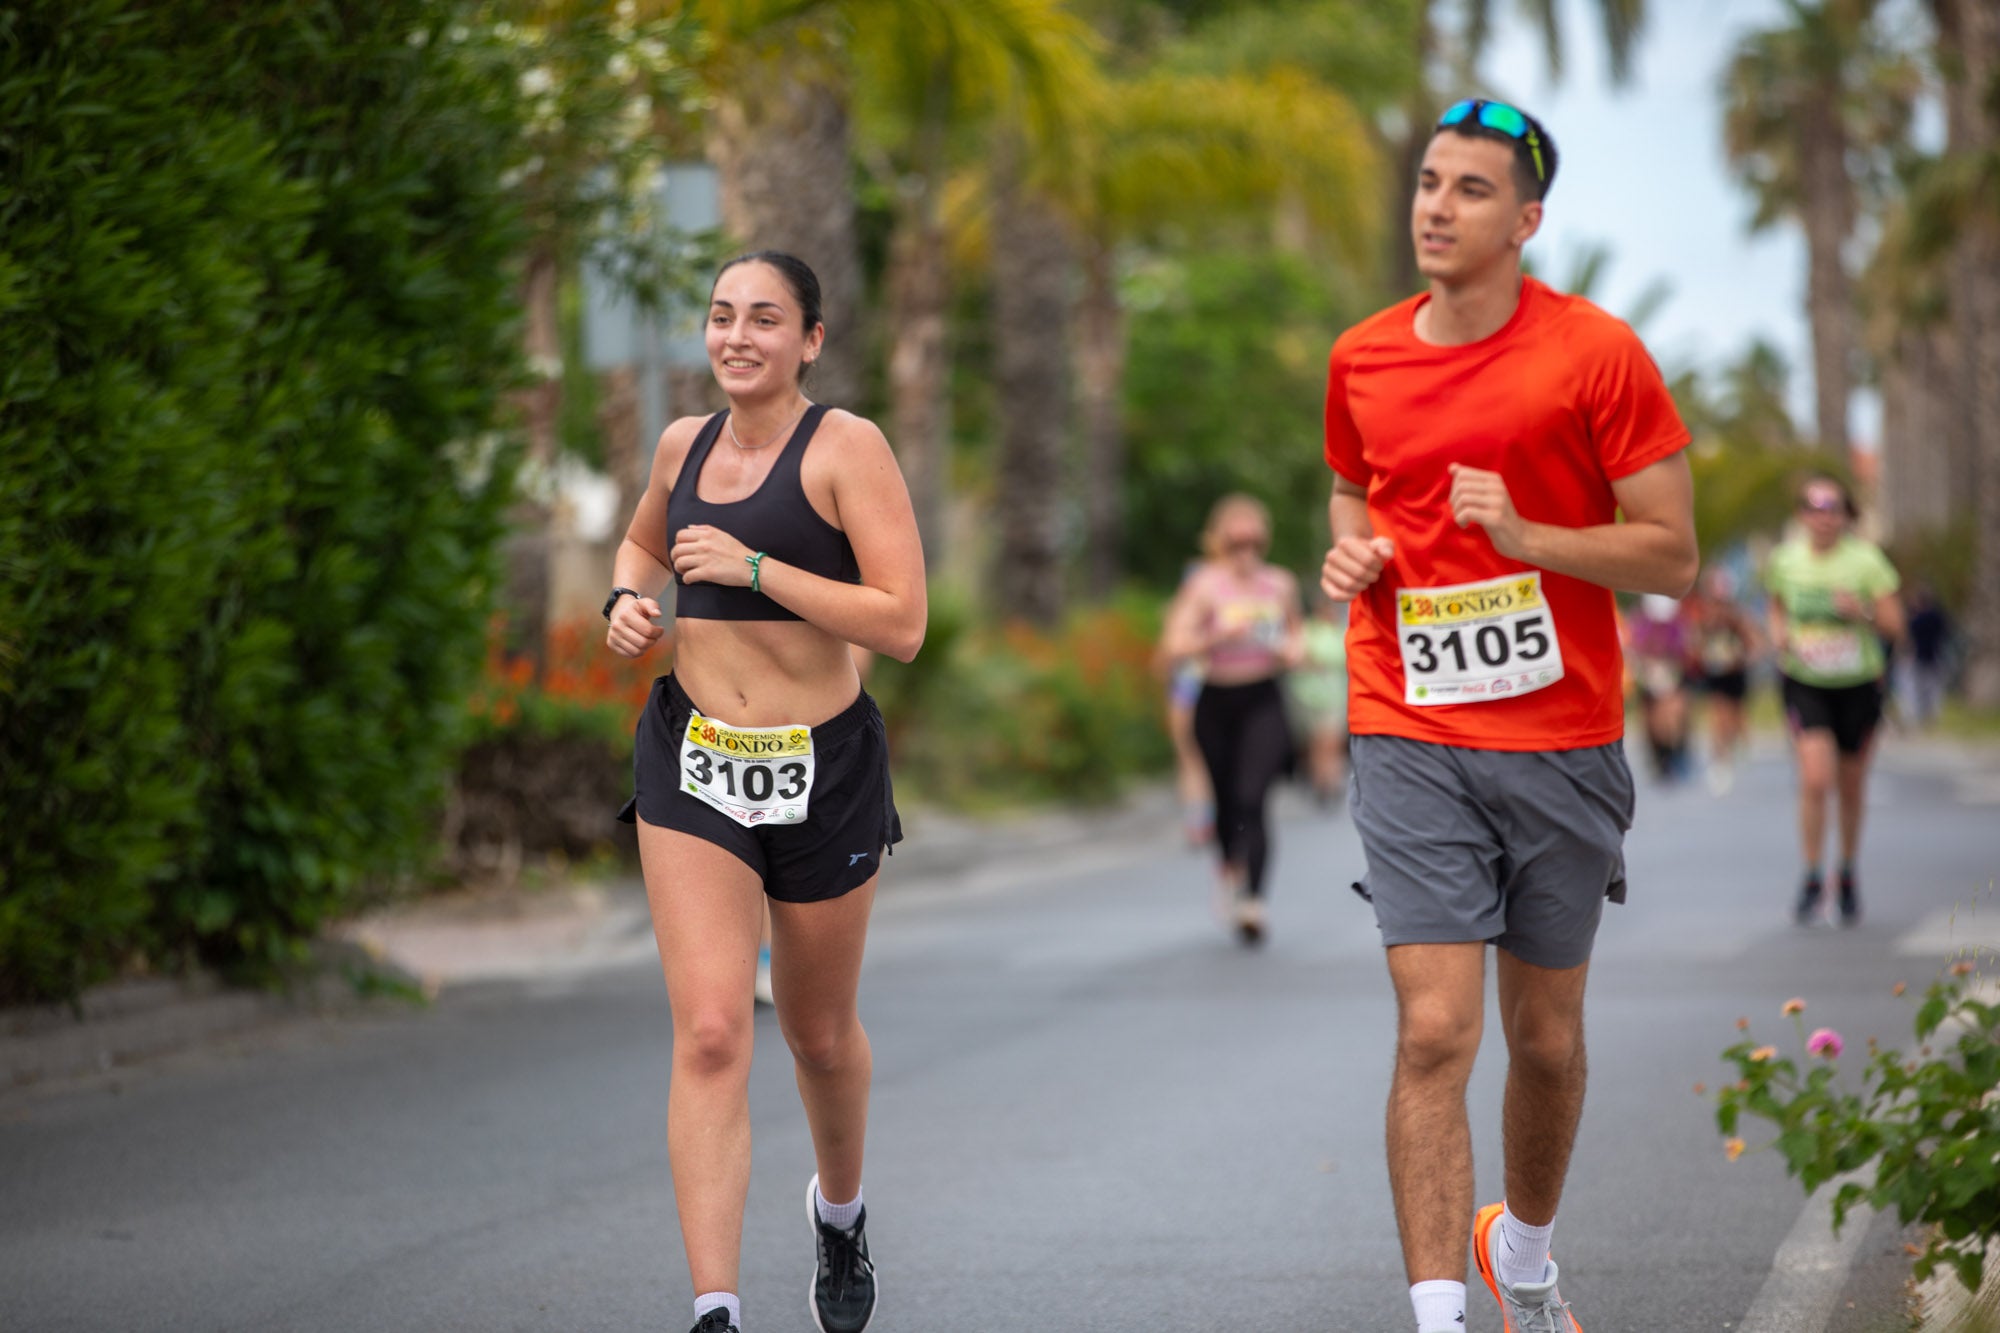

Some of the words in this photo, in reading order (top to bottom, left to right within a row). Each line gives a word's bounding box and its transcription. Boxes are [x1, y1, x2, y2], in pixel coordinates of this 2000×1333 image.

[1434, 594, 1513, 618] FONDO
[1407, 617, 1549, 673] 3105
[701, 724, 716, 743] 38
[716, 734, 783, 753] FONDO
[719, 729, 740, 739] GRAN
[742, 733, 776, 741] PREMIO
[685, 749, 807, 801] 3103
